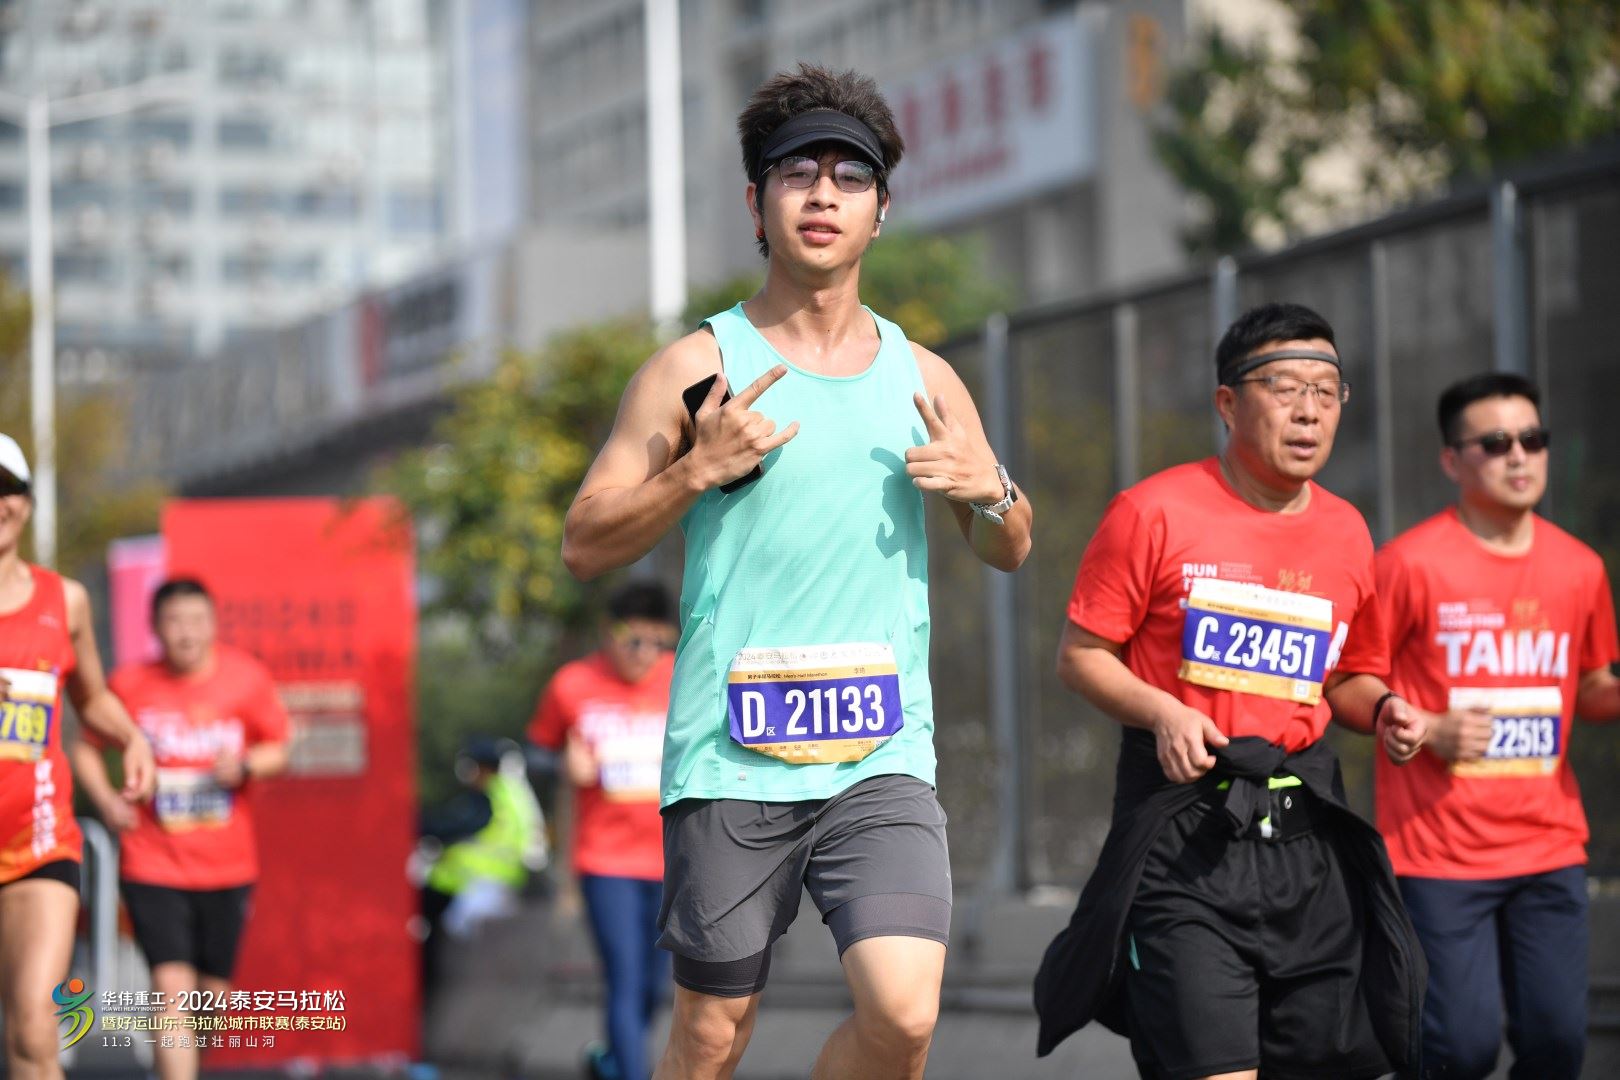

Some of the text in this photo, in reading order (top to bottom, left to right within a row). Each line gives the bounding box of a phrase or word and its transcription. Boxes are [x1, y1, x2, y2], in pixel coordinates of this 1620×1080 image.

[1182, 563, 1217, 577] RUN
[1224, 622, 1316, 676] 23451
[784, 683, 886, 736] 21133
[1486, 717, 1555, 758] 22513
